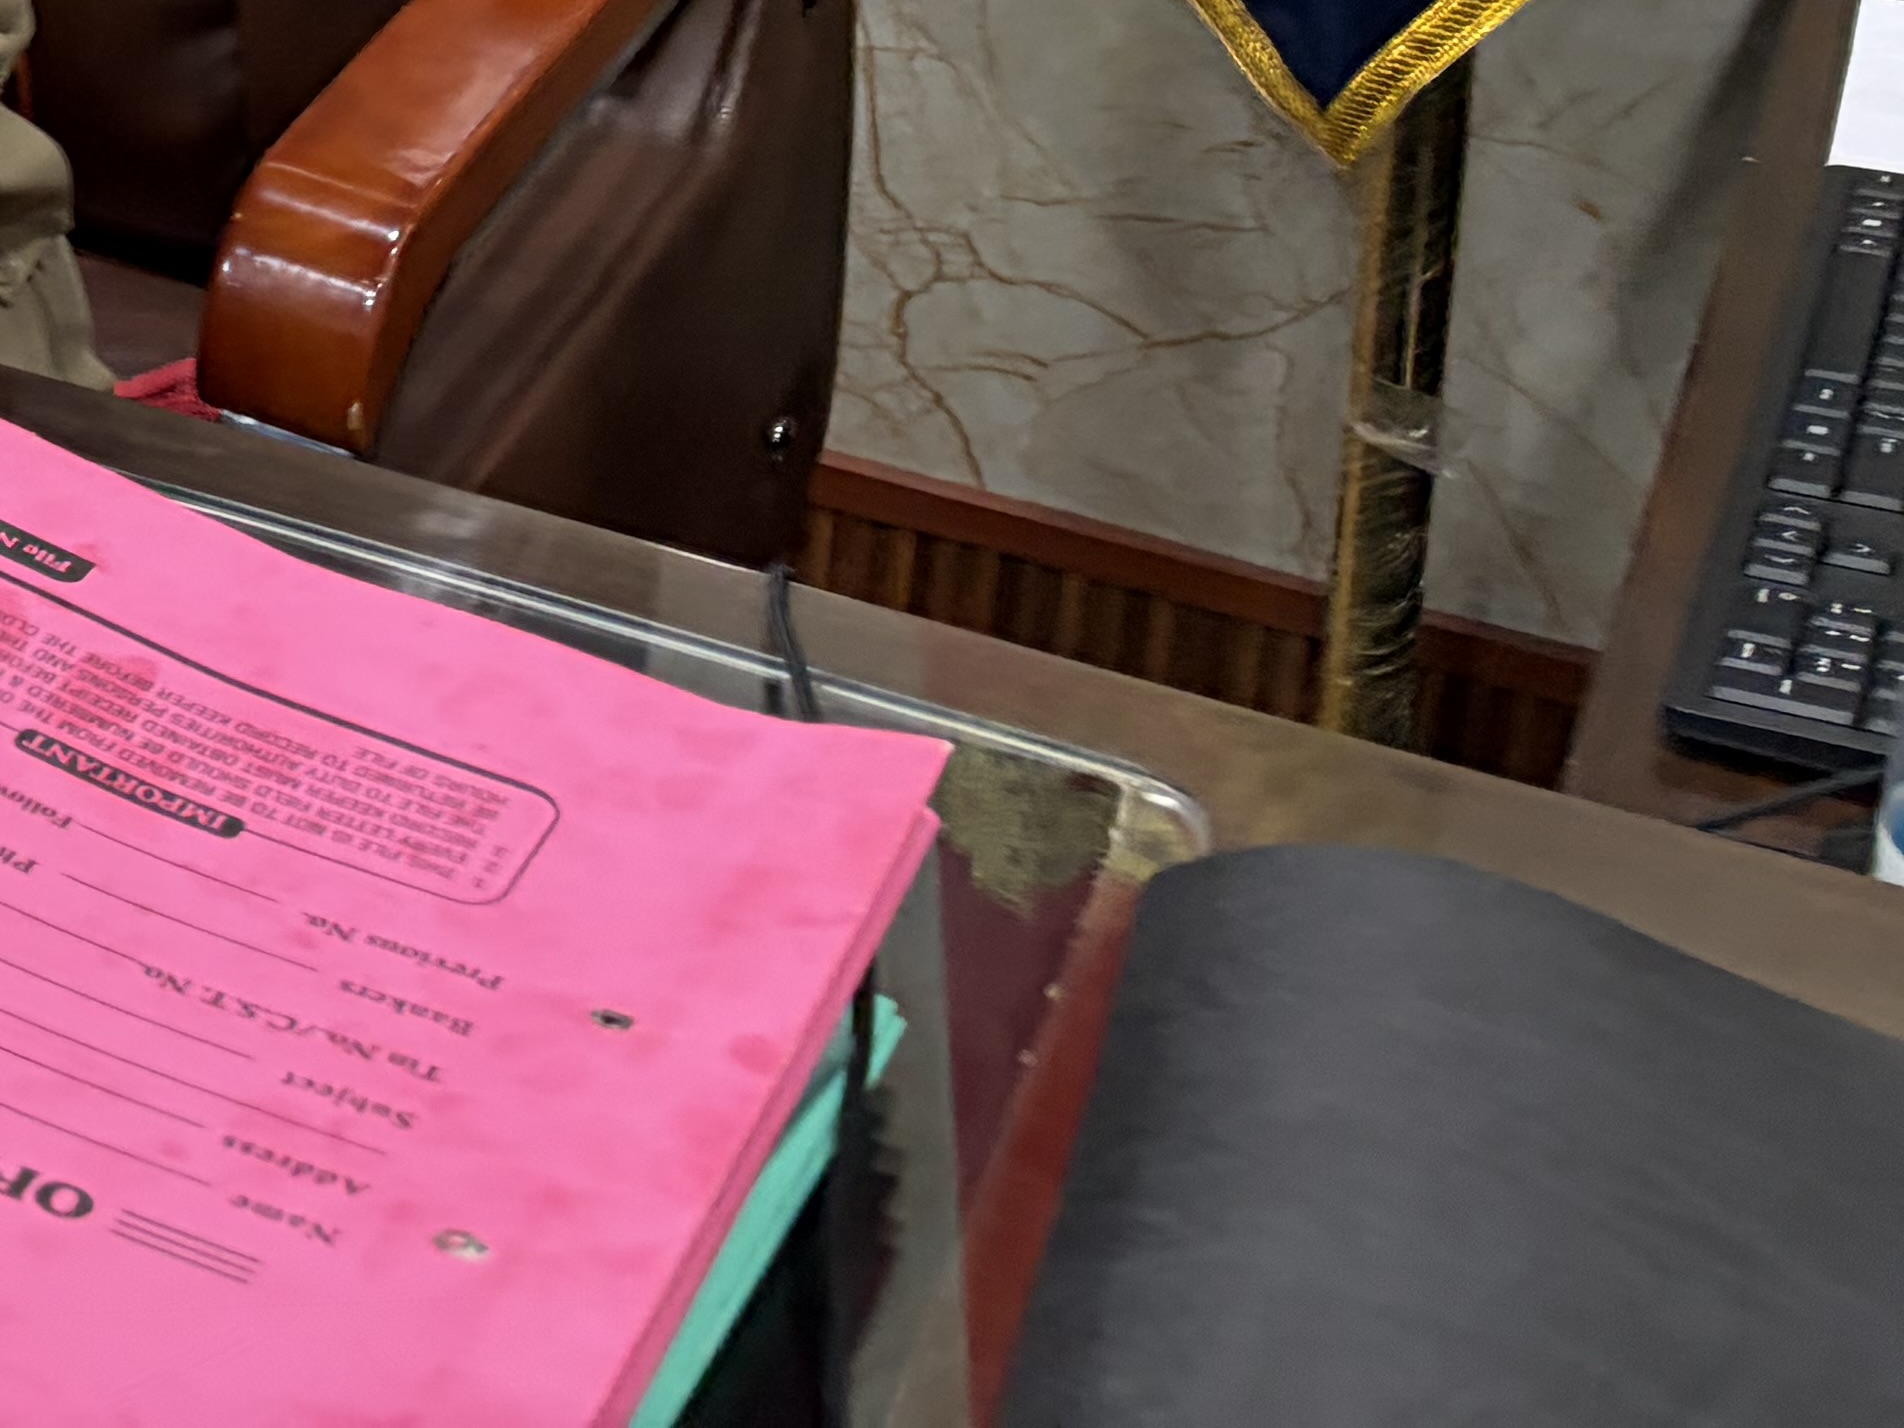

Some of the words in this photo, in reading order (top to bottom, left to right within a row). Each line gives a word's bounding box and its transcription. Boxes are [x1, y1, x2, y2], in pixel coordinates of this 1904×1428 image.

[22, 543, 73, 573] File
[31, 647, 74, 672] AND
[40, 632, 79, 656] THE
[79, 651, 154, 692] BEFORE
[16, 699, 54, 723] THE
[25, 684, 135, 741] NUMBERED
[57, 679, 139, 723] RECEIPT
[74, 668, 167, 718] PERSONS
[155, 687, 232, 727] KEEPER
[56, 718, 117, 753] FROM
[139, 718, 239, 767] OBTAINED
[167, 713, 302, 772] AUTHORITIES
[116, 747, 217, 797] REMOVED
[165, 750, 251, 790] SHOULD
[319, 752, 350, 771] TO
[22, 733, 228, 832] IMPORTANT
[218, 789, 249, 808] BE
[303, 784, 388, 818] KEEPER
[362, 786, 394, 803] TO
[249, 800, 280, 819] TO
[314, 805, 397, 840] LETTER
[356, 838, 403, 862] FILE
[364, 935, 504, 991] Previous
[339, 980, 474, 1037] Bankers
[387, 1051, 441, 1082] Tin
[281, 1072, 415, 1129] Subject
[223, 1135, 371, 1194] Address
[229, 1195, 340, 1246] Name
